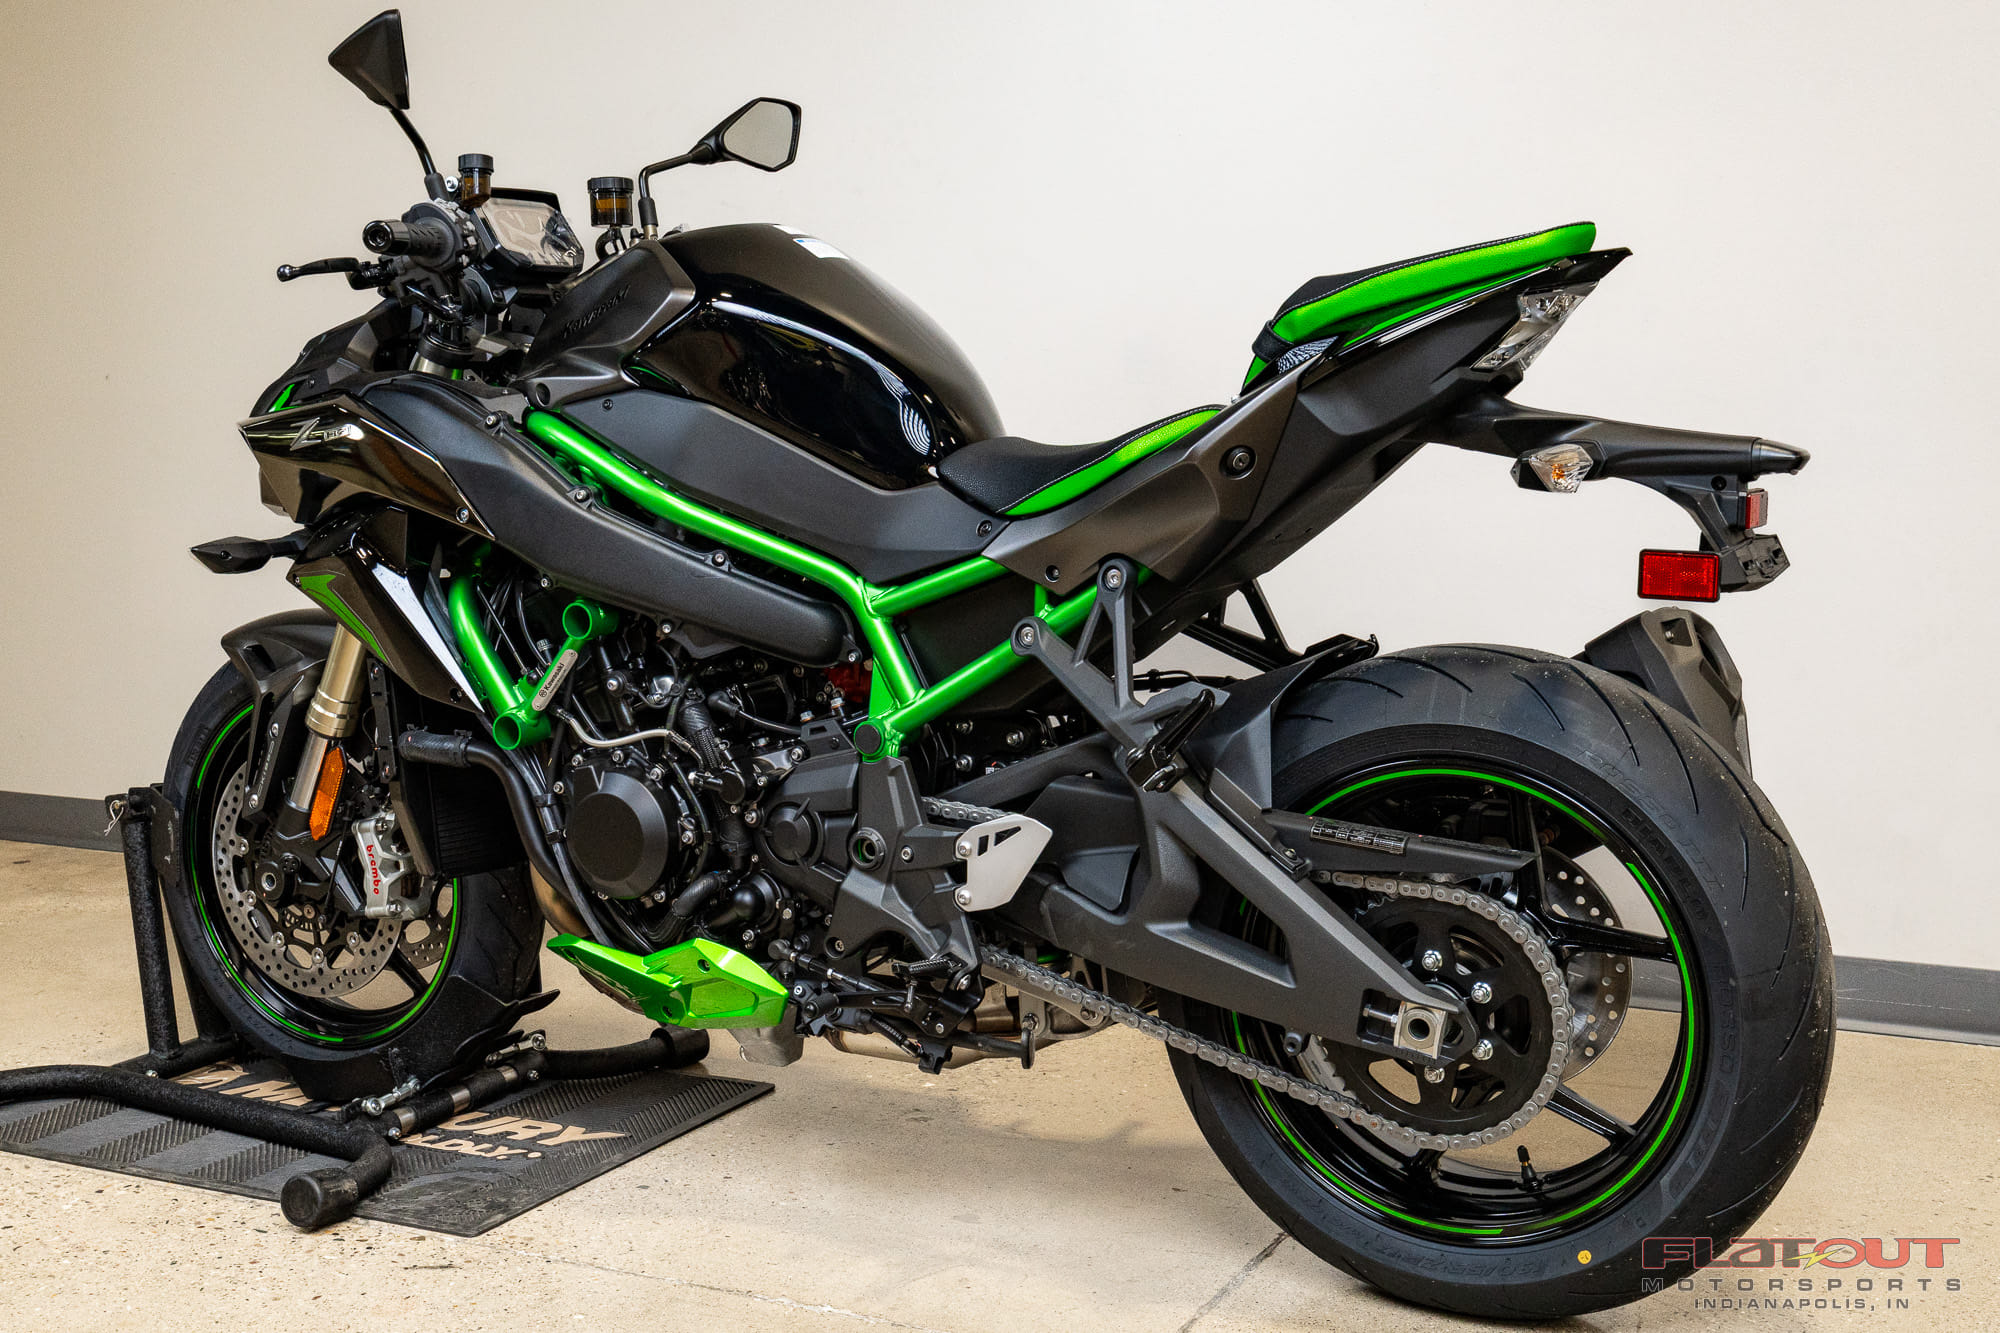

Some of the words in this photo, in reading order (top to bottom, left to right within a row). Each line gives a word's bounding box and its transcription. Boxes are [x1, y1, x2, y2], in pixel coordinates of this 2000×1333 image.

[290, 416, 321, 452] Z
[544, 662, 566, 691] Kawasaki
[366, 844, 382, 895] brembo
